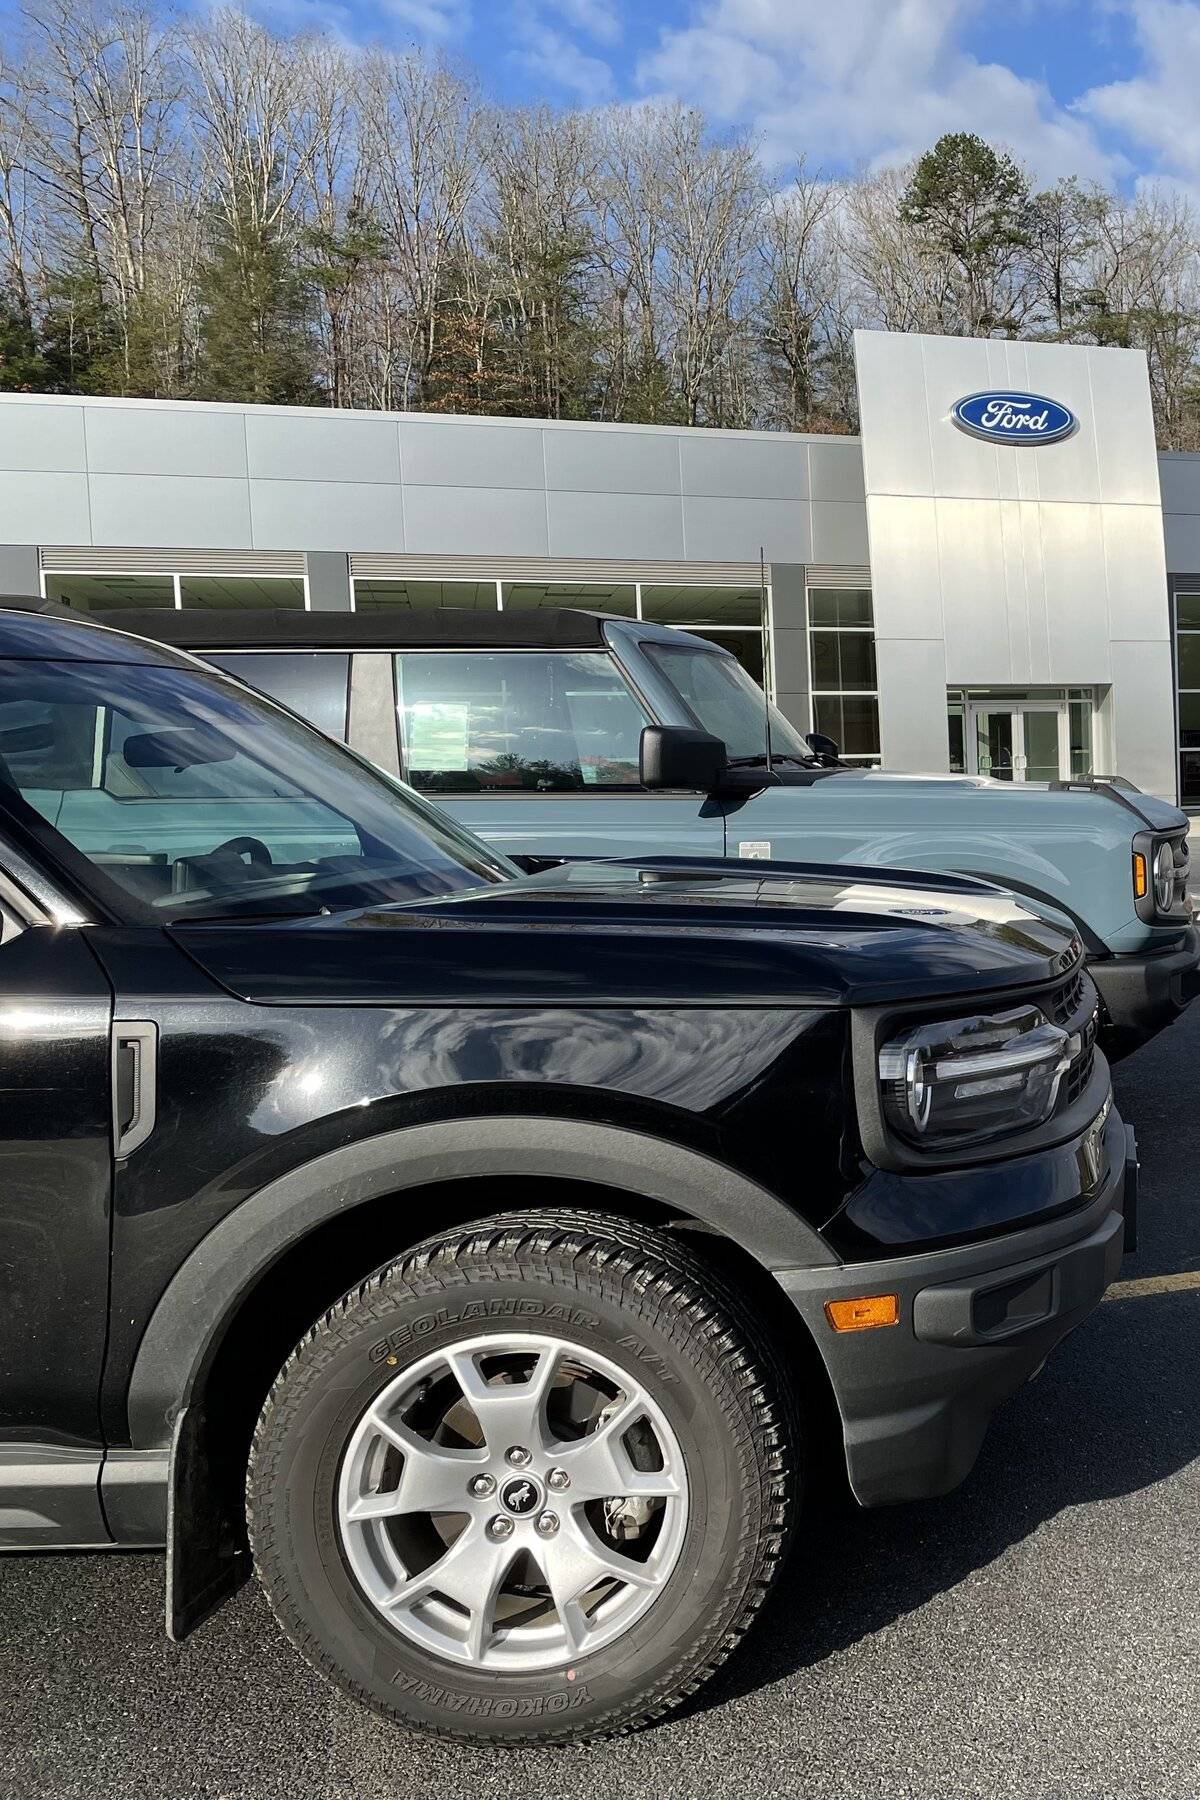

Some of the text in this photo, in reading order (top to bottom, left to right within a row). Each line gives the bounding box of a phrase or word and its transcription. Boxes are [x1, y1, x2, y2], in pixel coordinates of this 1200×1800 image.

[981, 400, 1048, 430] Ford
[368, 1298, 681, 1384] GEOLANDAR A/T
[391, 1669, 595, 1719] YOKOHAMA
